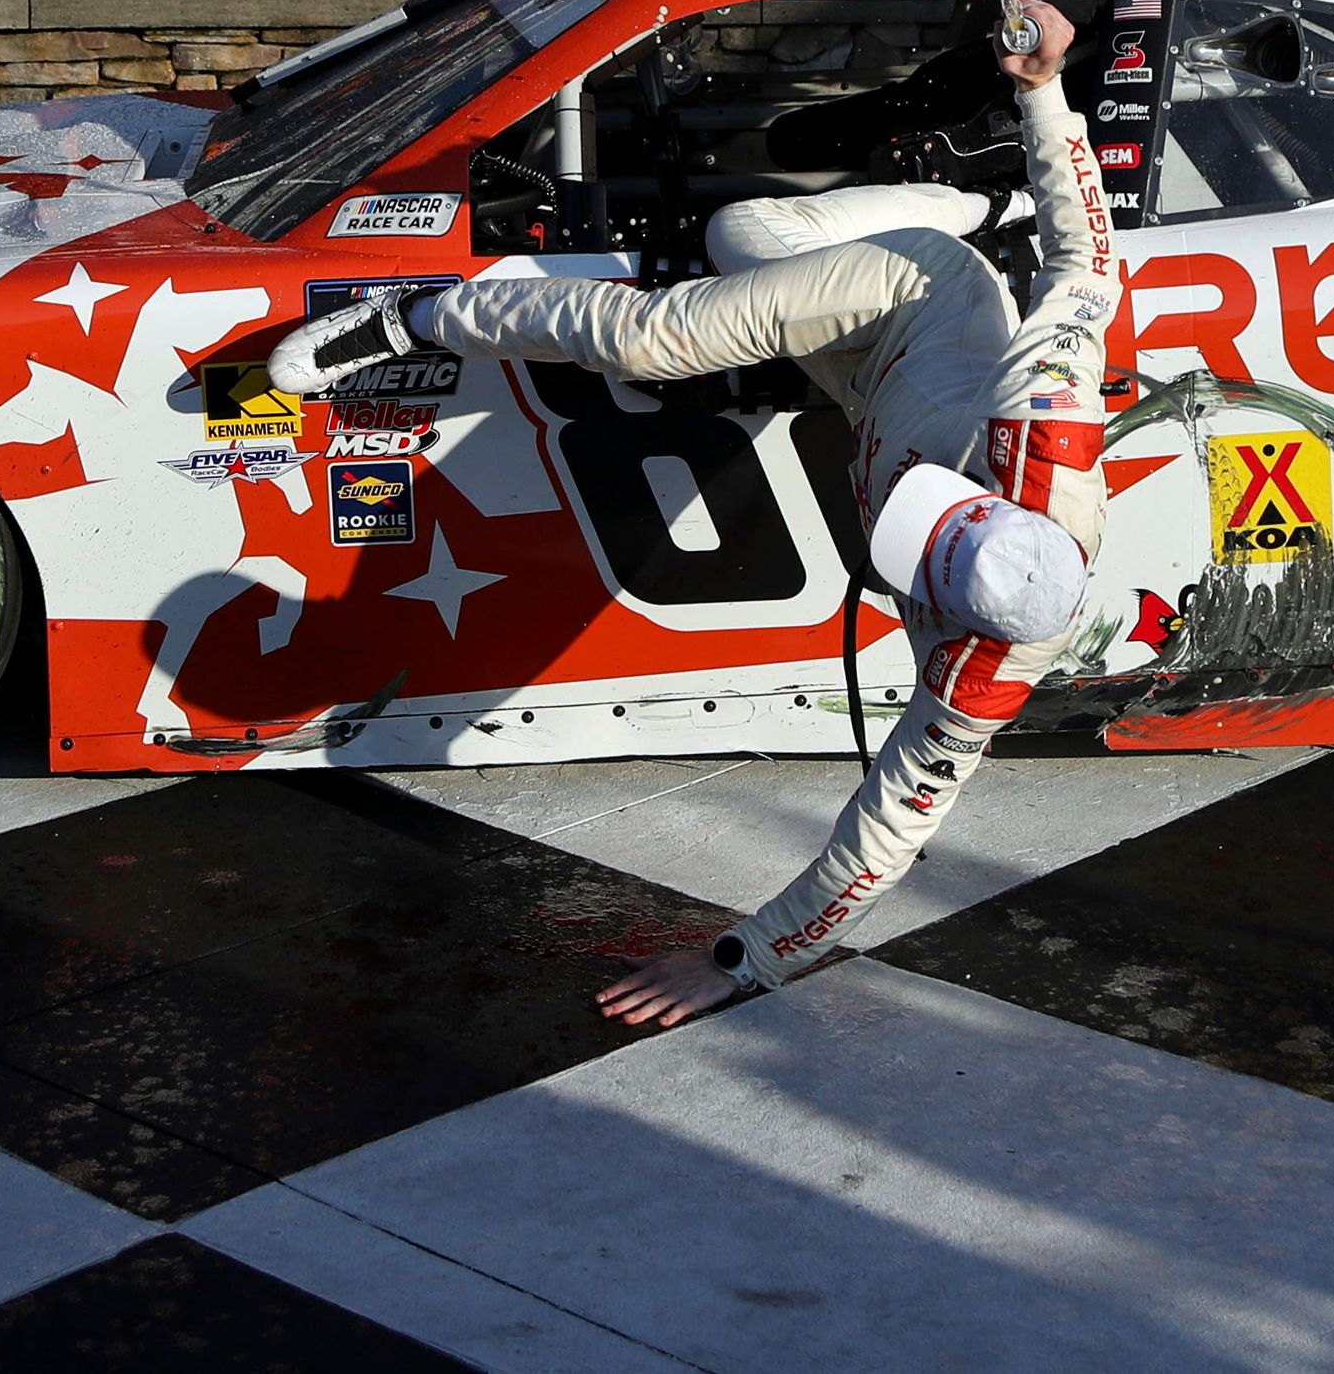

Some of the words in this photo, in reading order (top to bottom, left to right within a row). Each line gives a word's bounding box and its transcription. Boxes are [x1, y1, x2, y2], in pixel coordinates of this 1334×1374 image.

[1119, 103, 1149, 114] Miller
[1101, 149, 1133, 164] SEM
[373, 198, 443, 213] NASCAR
[1067, 136, 1113, 276] REGISTIX
[347, 216, 387, 230] RACE
[395, 215, 433, 229] CAR
[320, 360, 457, 394] OMETIC
[318, 390, 376, 399] GASKET
[329, 401, 437, 436] Holley
[208, 421, 298, 438] KENNAMETAL
[326, 432, 420, 458] MSD
[995, 426, 1011, 467] OMP
[192, 451, 234, 467] FIVE
[244, 449, 287, 464] STAR
[340, 483, 402, 499] SUNOCO
[338, 513, 407, 528] ROOKIE
[341, 528, 405, 537] CONTENDER
[1223, 527, 1317, 552] KOA
[943, 526, 966, 586] REGISTIX
[930, 649, 950, 689] OMP
[770, 867, 884, 960] REGISTIX
